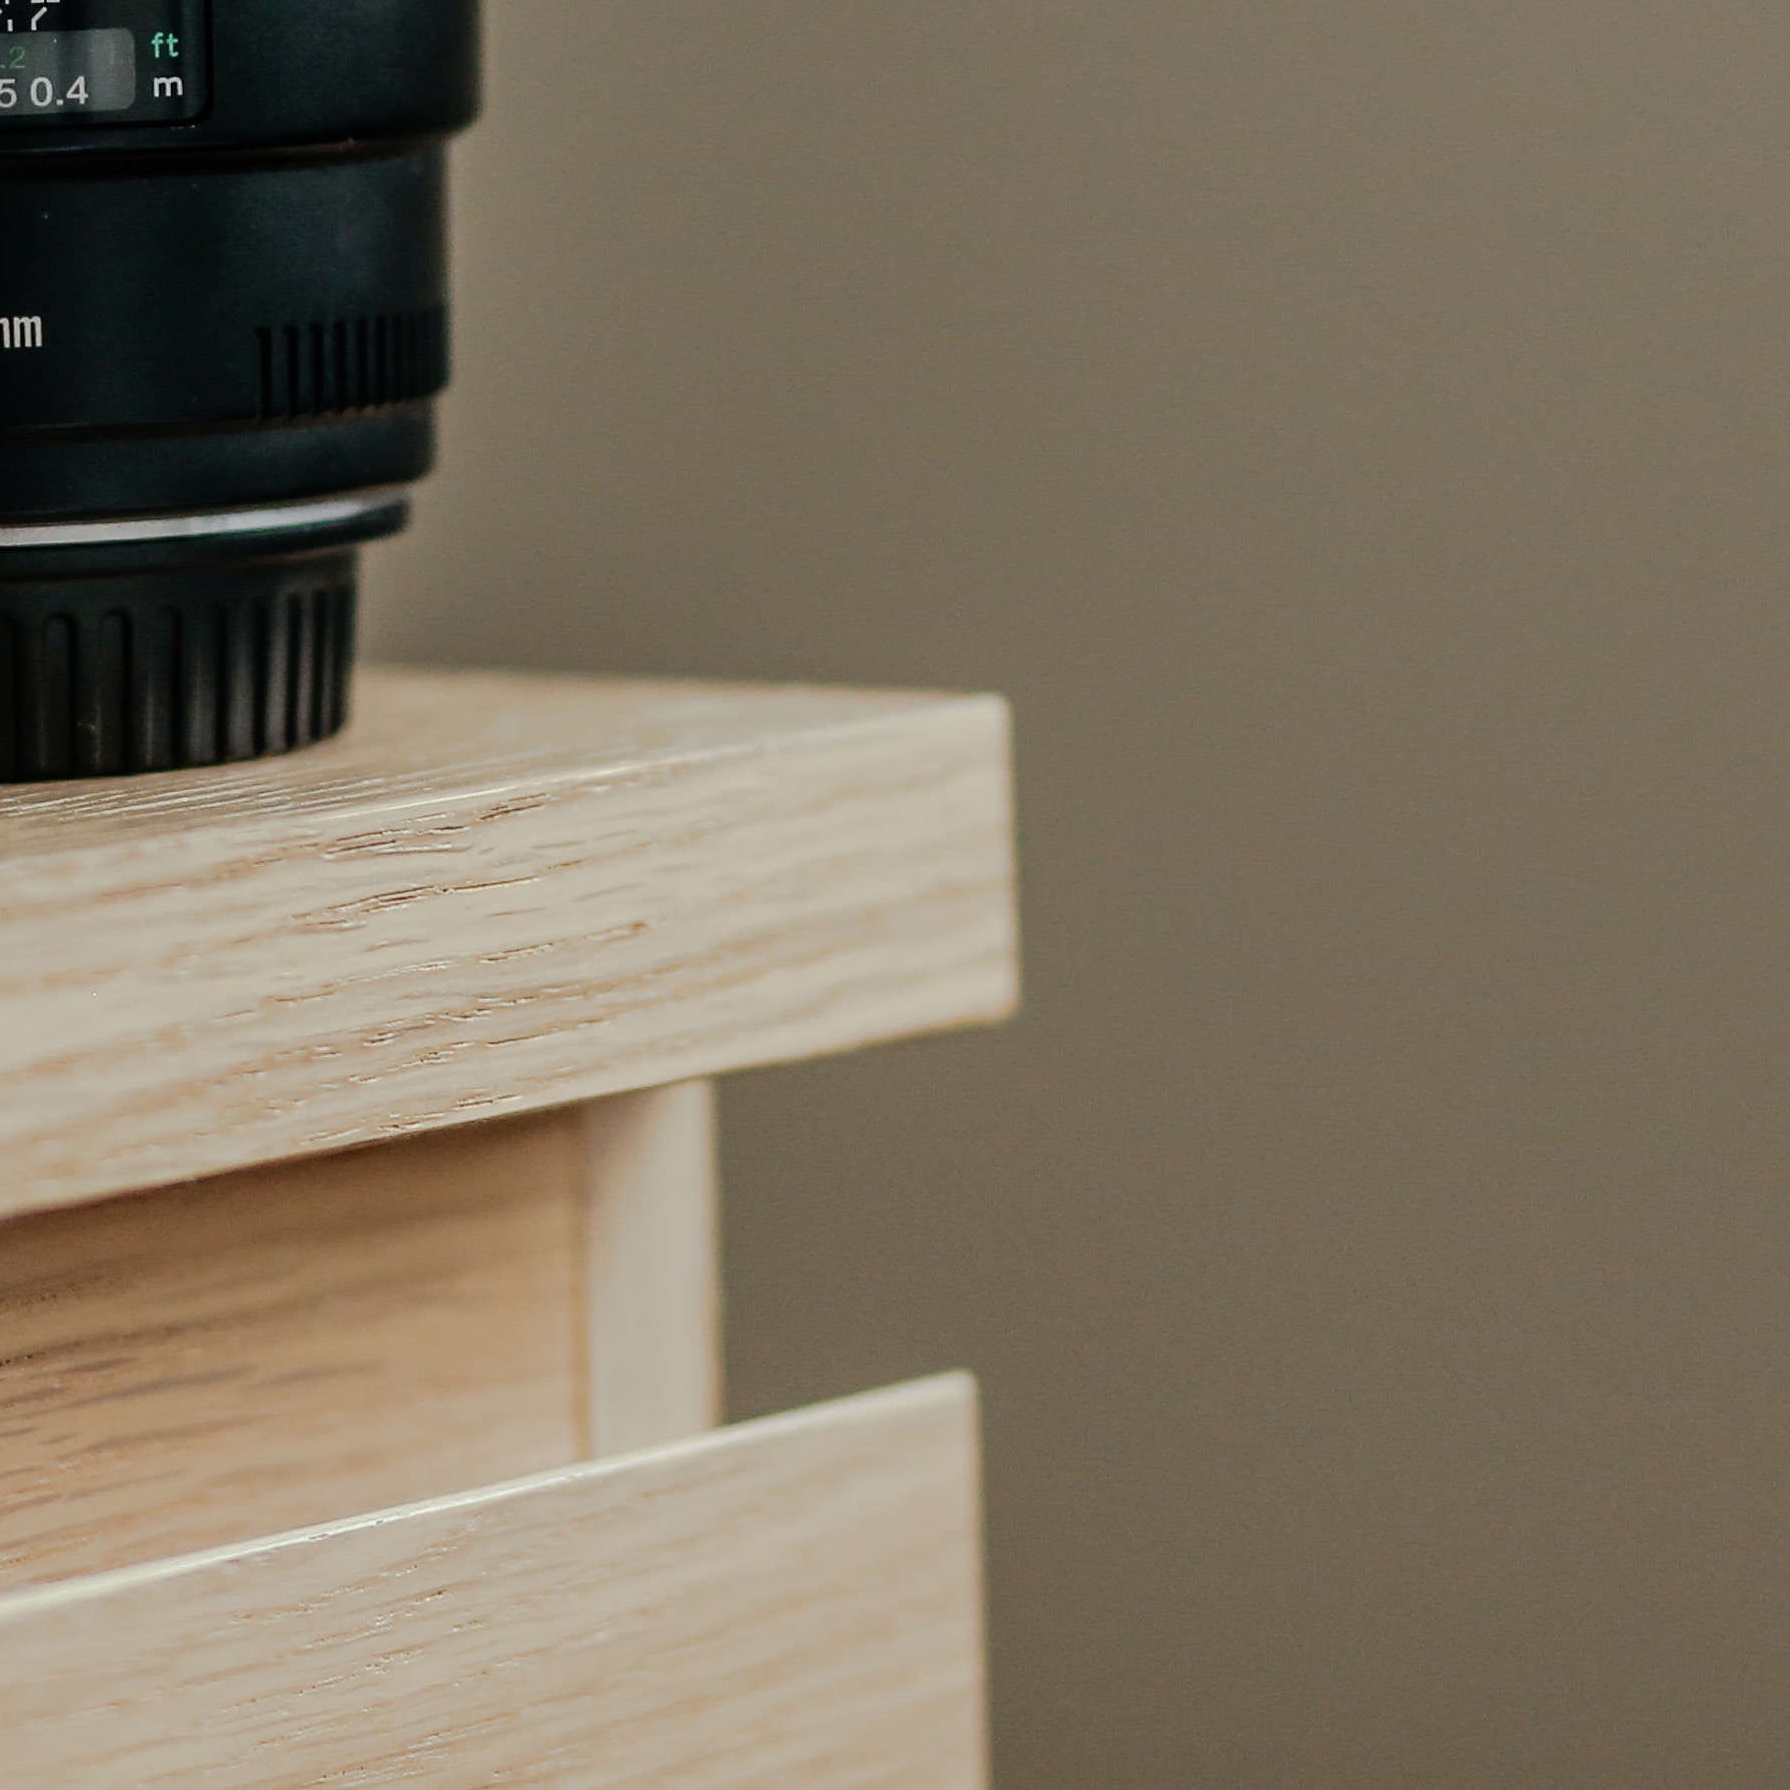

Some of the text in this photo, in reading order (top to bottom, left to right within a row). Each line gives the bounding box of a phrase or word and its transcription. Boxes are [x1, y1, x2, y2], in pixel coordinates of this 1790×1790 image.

[151, 32, 179, 58] ft
[30, 76, 88, 105] 0.4
[153, 76, 183, 97] m
